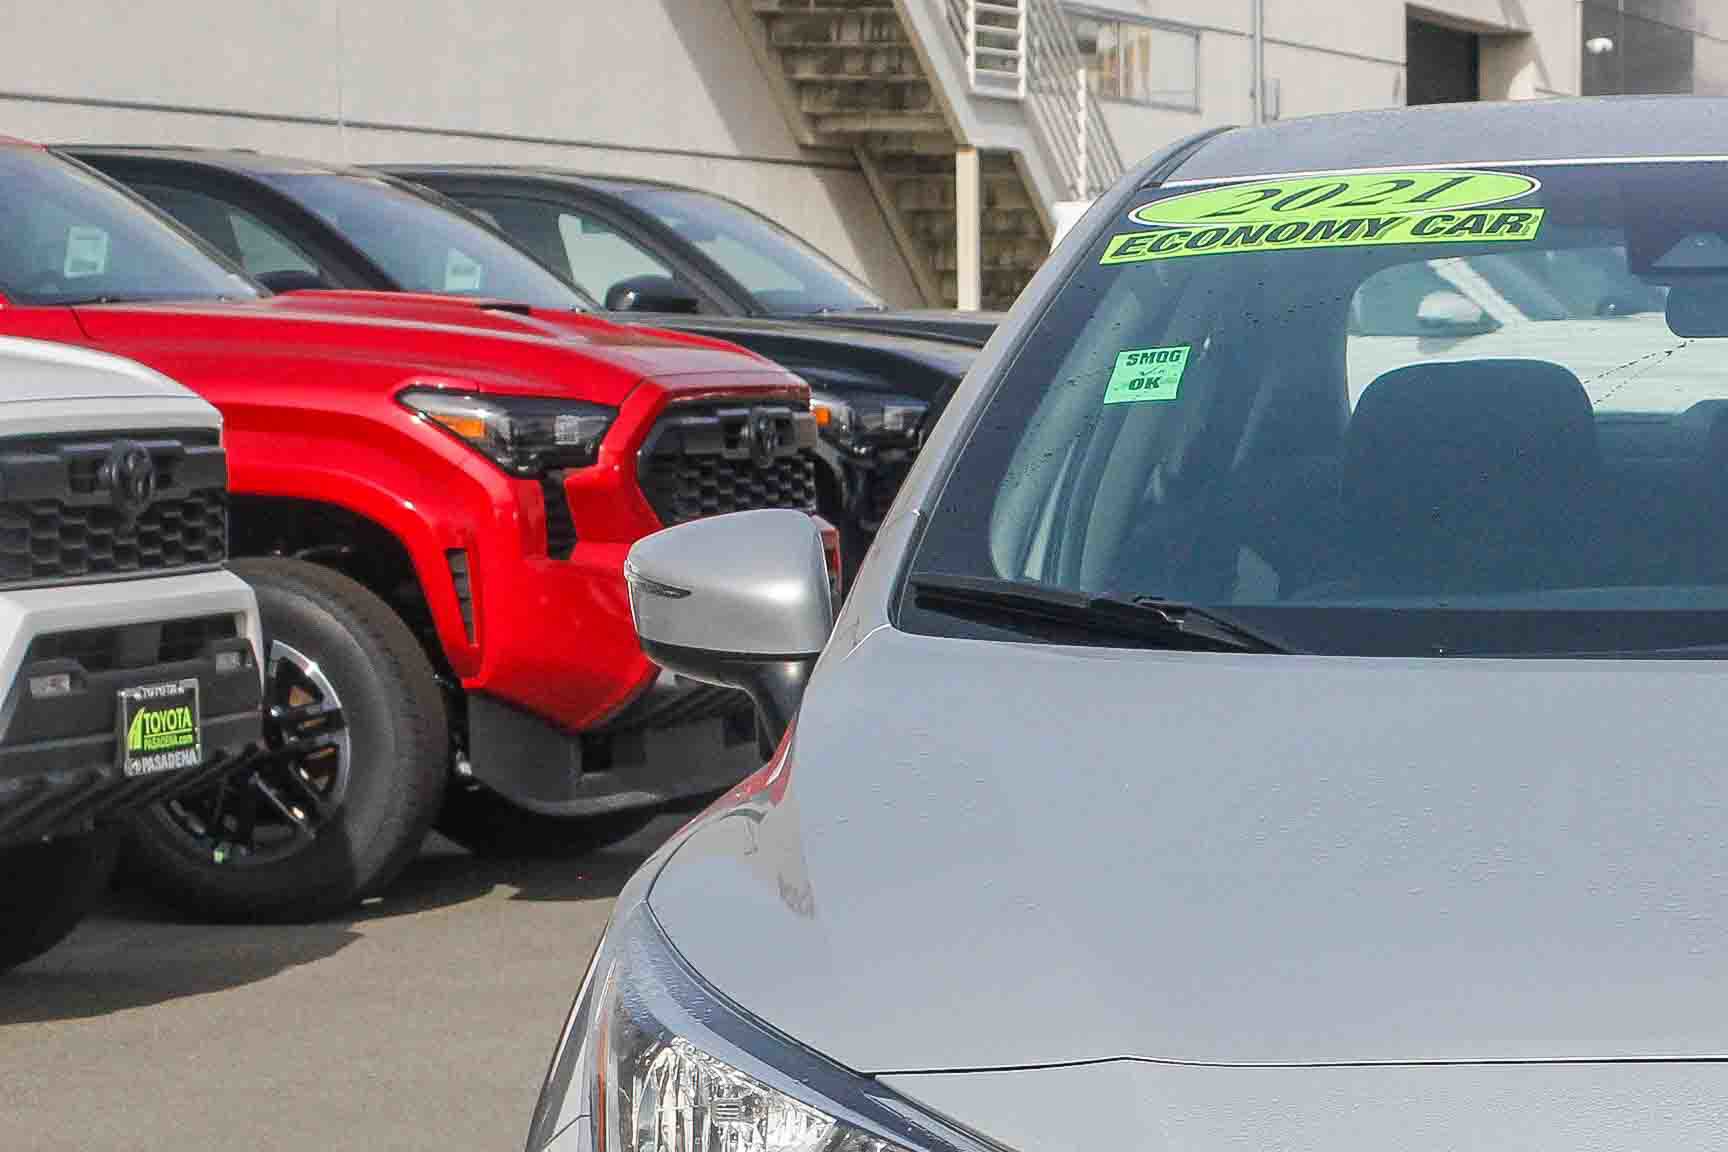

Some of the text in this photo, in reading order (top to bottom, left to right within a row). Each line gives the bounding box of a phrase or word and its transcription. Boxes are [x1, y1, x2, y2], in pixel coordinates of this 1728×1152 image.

[1195, 175, 1476, 219] 2021
[1109, 211, 1535, 259] ECONOMY CAR
[1126, 350, 1183, 367] SMOG
[1128, 376, 1162, 391] OK
[143, 706, 192, 734] TOYOTA
[142, 748, 198, 774] PASADENA
